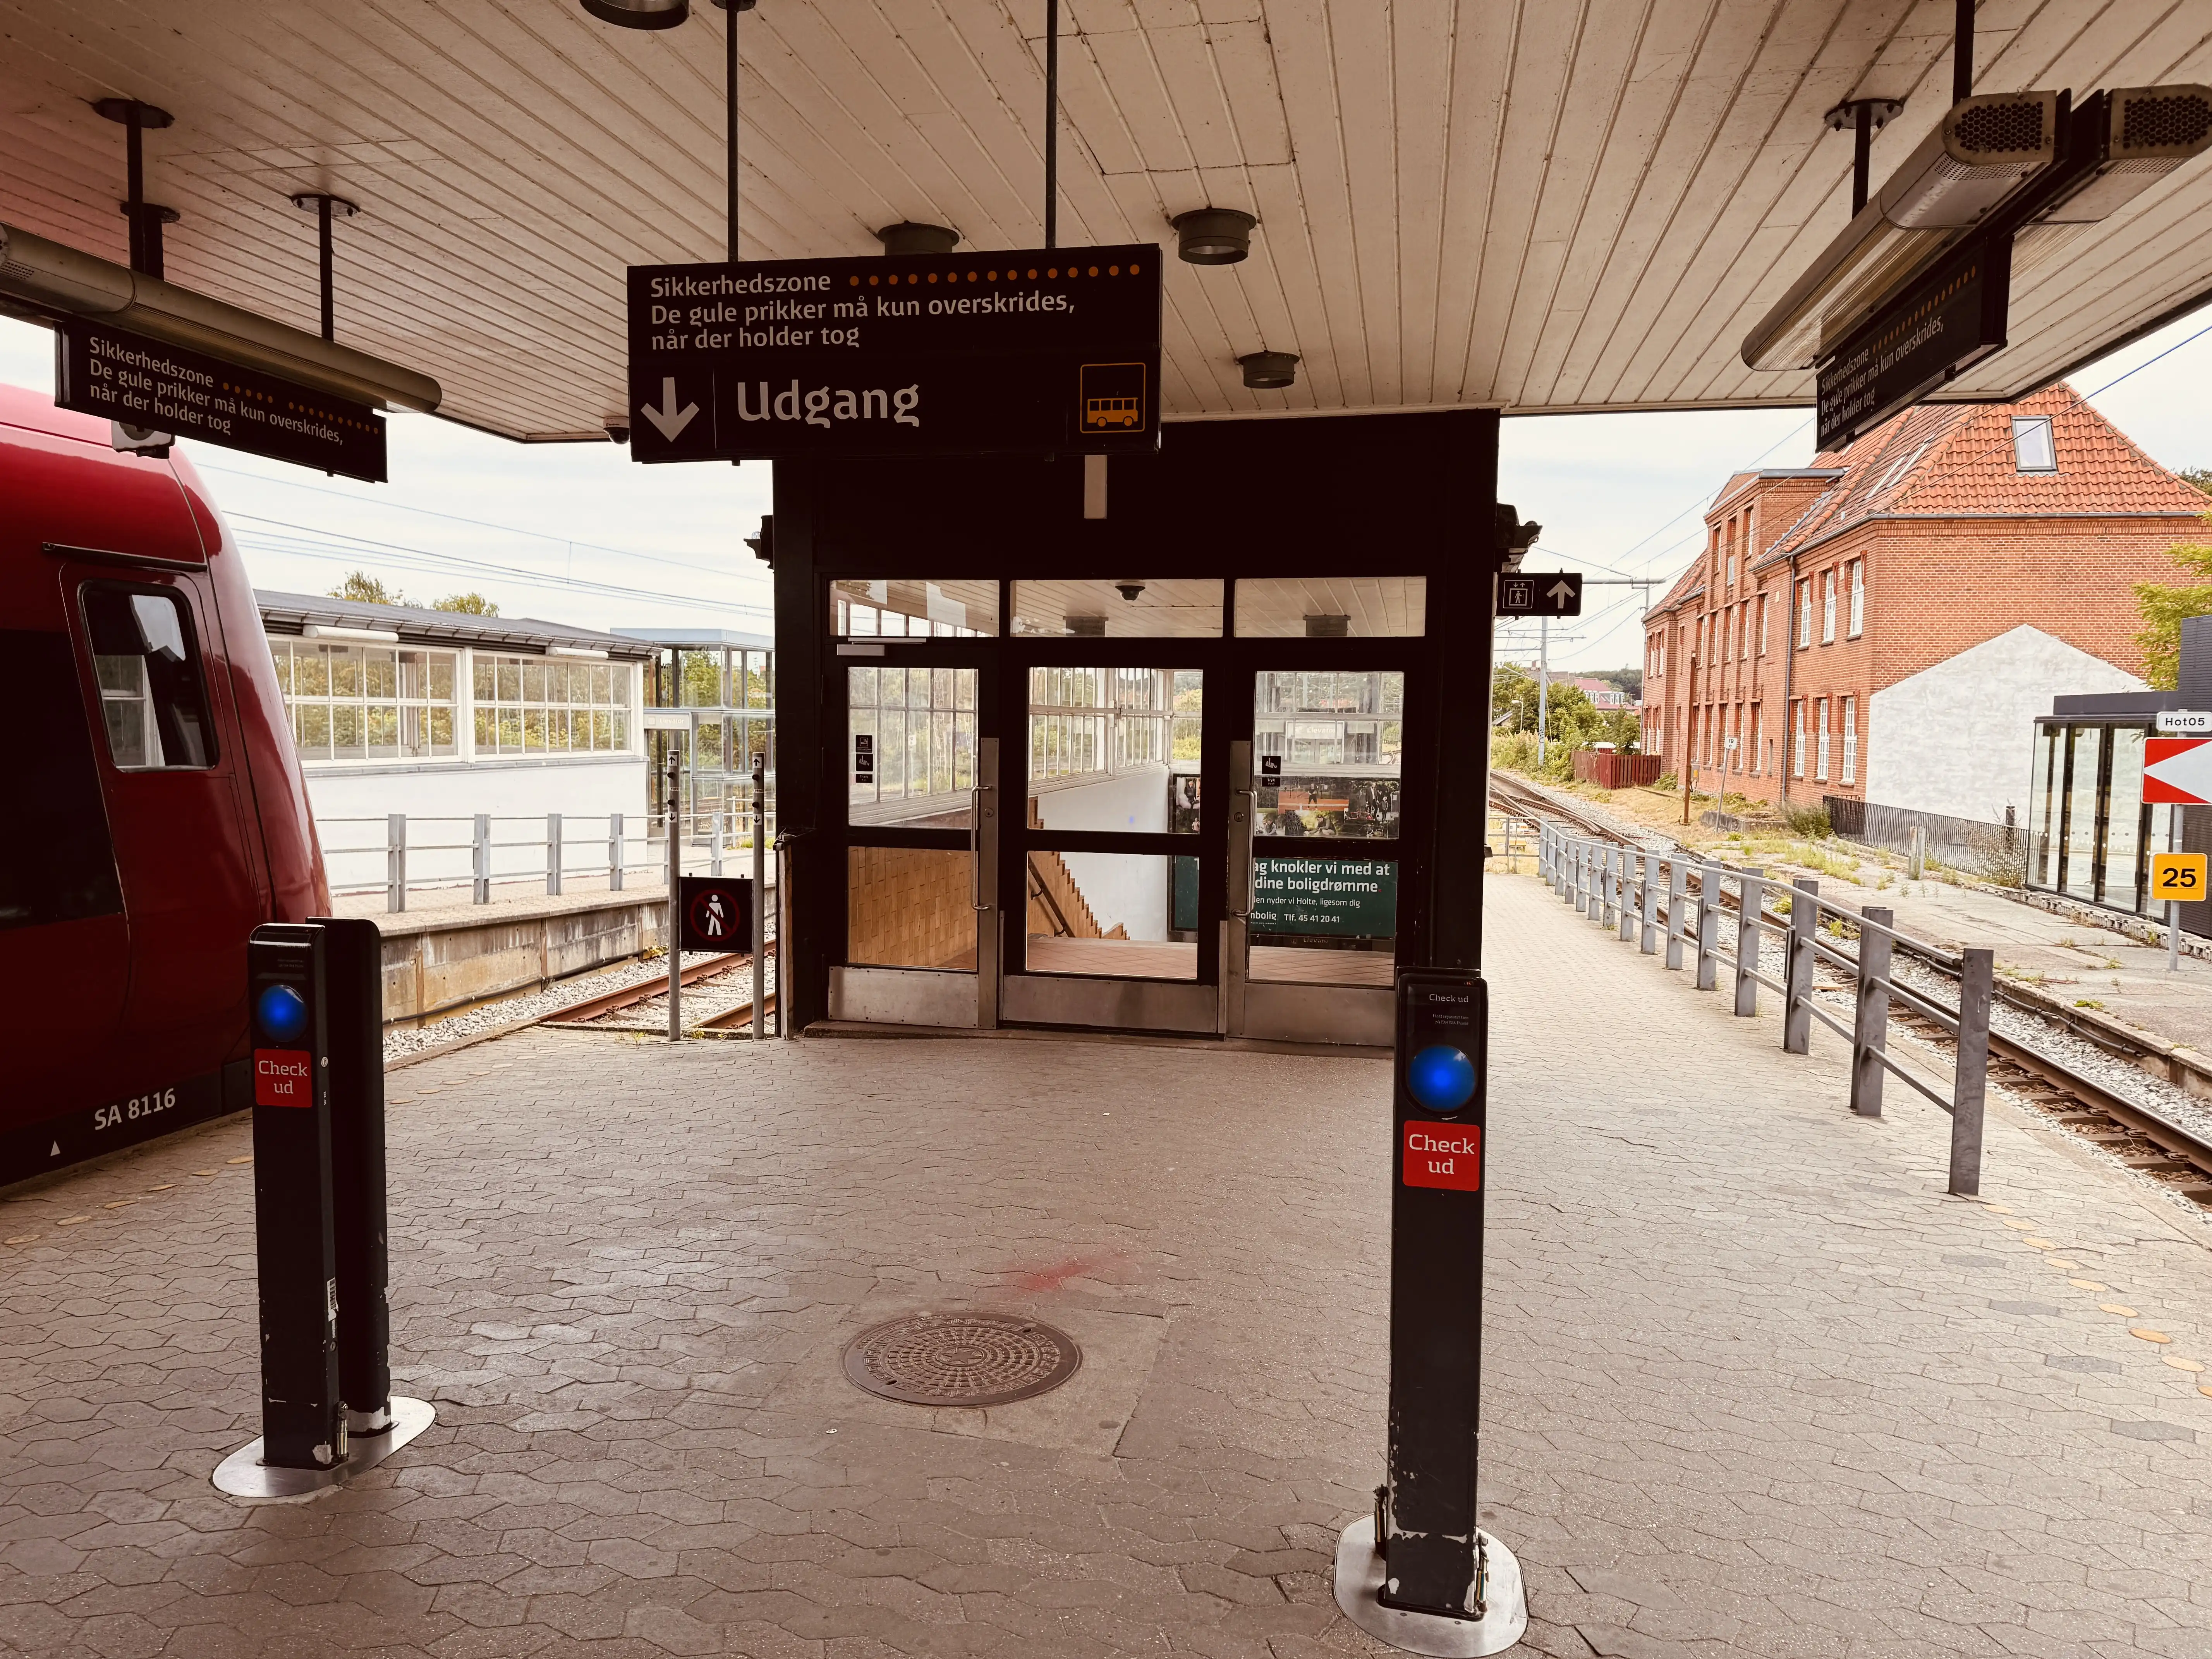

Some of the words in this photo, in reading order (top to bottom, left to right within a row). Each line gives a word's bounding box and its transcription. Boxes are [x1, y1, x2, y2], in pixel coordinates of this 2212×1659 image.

[651, 273, 830, 297] Sikkerhedszone
[652, 305, 680, 324] De
[690, 302, 737, 326] gule
[745, 299, 826, 326] prikker
[834, 296, 868, 317] må
[878, 296, 919, 316] kun
[929, 290, 1075, 314] overskrides,
[652, 329, 688, 349] når
[695, 329, 732, 348] der
[740, 326, 813, 347] holder
[821, 327, 859, 347] tog
[90, 337, 213, 387] Sikkerhedszone
[1821, 400, 1829, 416] De
[1830, 388, 1842, 411] gule
[1844, 373, 1866, 404] prikker
[1868, 358, 1878, 382] må
[1881, 352, 1893, 373] kun
[1896, 316, 1943, 362] overskrides,
[1822, 349, 1869, 395] Sikkerhedszone
[90, 358, 112, 380] De
[118, 371, 152, 390] gule
[158, 382, 210, 406] prikker
[215, 398, 236, 414] må
[241, 401, 265, 422] kun
[270, 414, 343, 445] overskrides,
[90, 383, 118, 402] når
[123, 391, 149, 410] der
[155, 397, 203, 424] holder
[208, 414, 230, 436] tog
[738, 380, 919, 428] Udgang
[1821, 418, 1830, 437] når
[1831, 412, 1841, 429] der
[1842, 397, 1862, 422] holder
[1864, 386, 1875, 407] tog
[2165, 717, 2205, 726] Hot05
[1271, 859, 1322, 874] knokler
[1325, 861, 1337, 874] vi
[1341, 862, 1371, 875] med
[1376, 864, 1390, 876] at
[2162, 867, 2197, 888] 25
[1255, 876, 1283, 889] dine
[1288, 877, 1382, 894] boligdrømme.
[1267, 897, 1286, 905] nyder
[1297, 898, 1317, 906] Holte,
[1320, 898, 1347, 907] ligesom
[1349, 899, 1360, 908] dig
[1250, 911, 1277, 921] nbolig
[1429, 994, 1456, 1002] Check
[259, 1060, 307, 1077] Check
[273, 1080, 294, 1094] ud
[94, 1105, 122, 1130] SA
[128, 1087, 176, 1120] 8116
[1409, 1134, 1475, 1154] Check
[1427, 1158, 1454, 1175] ud
